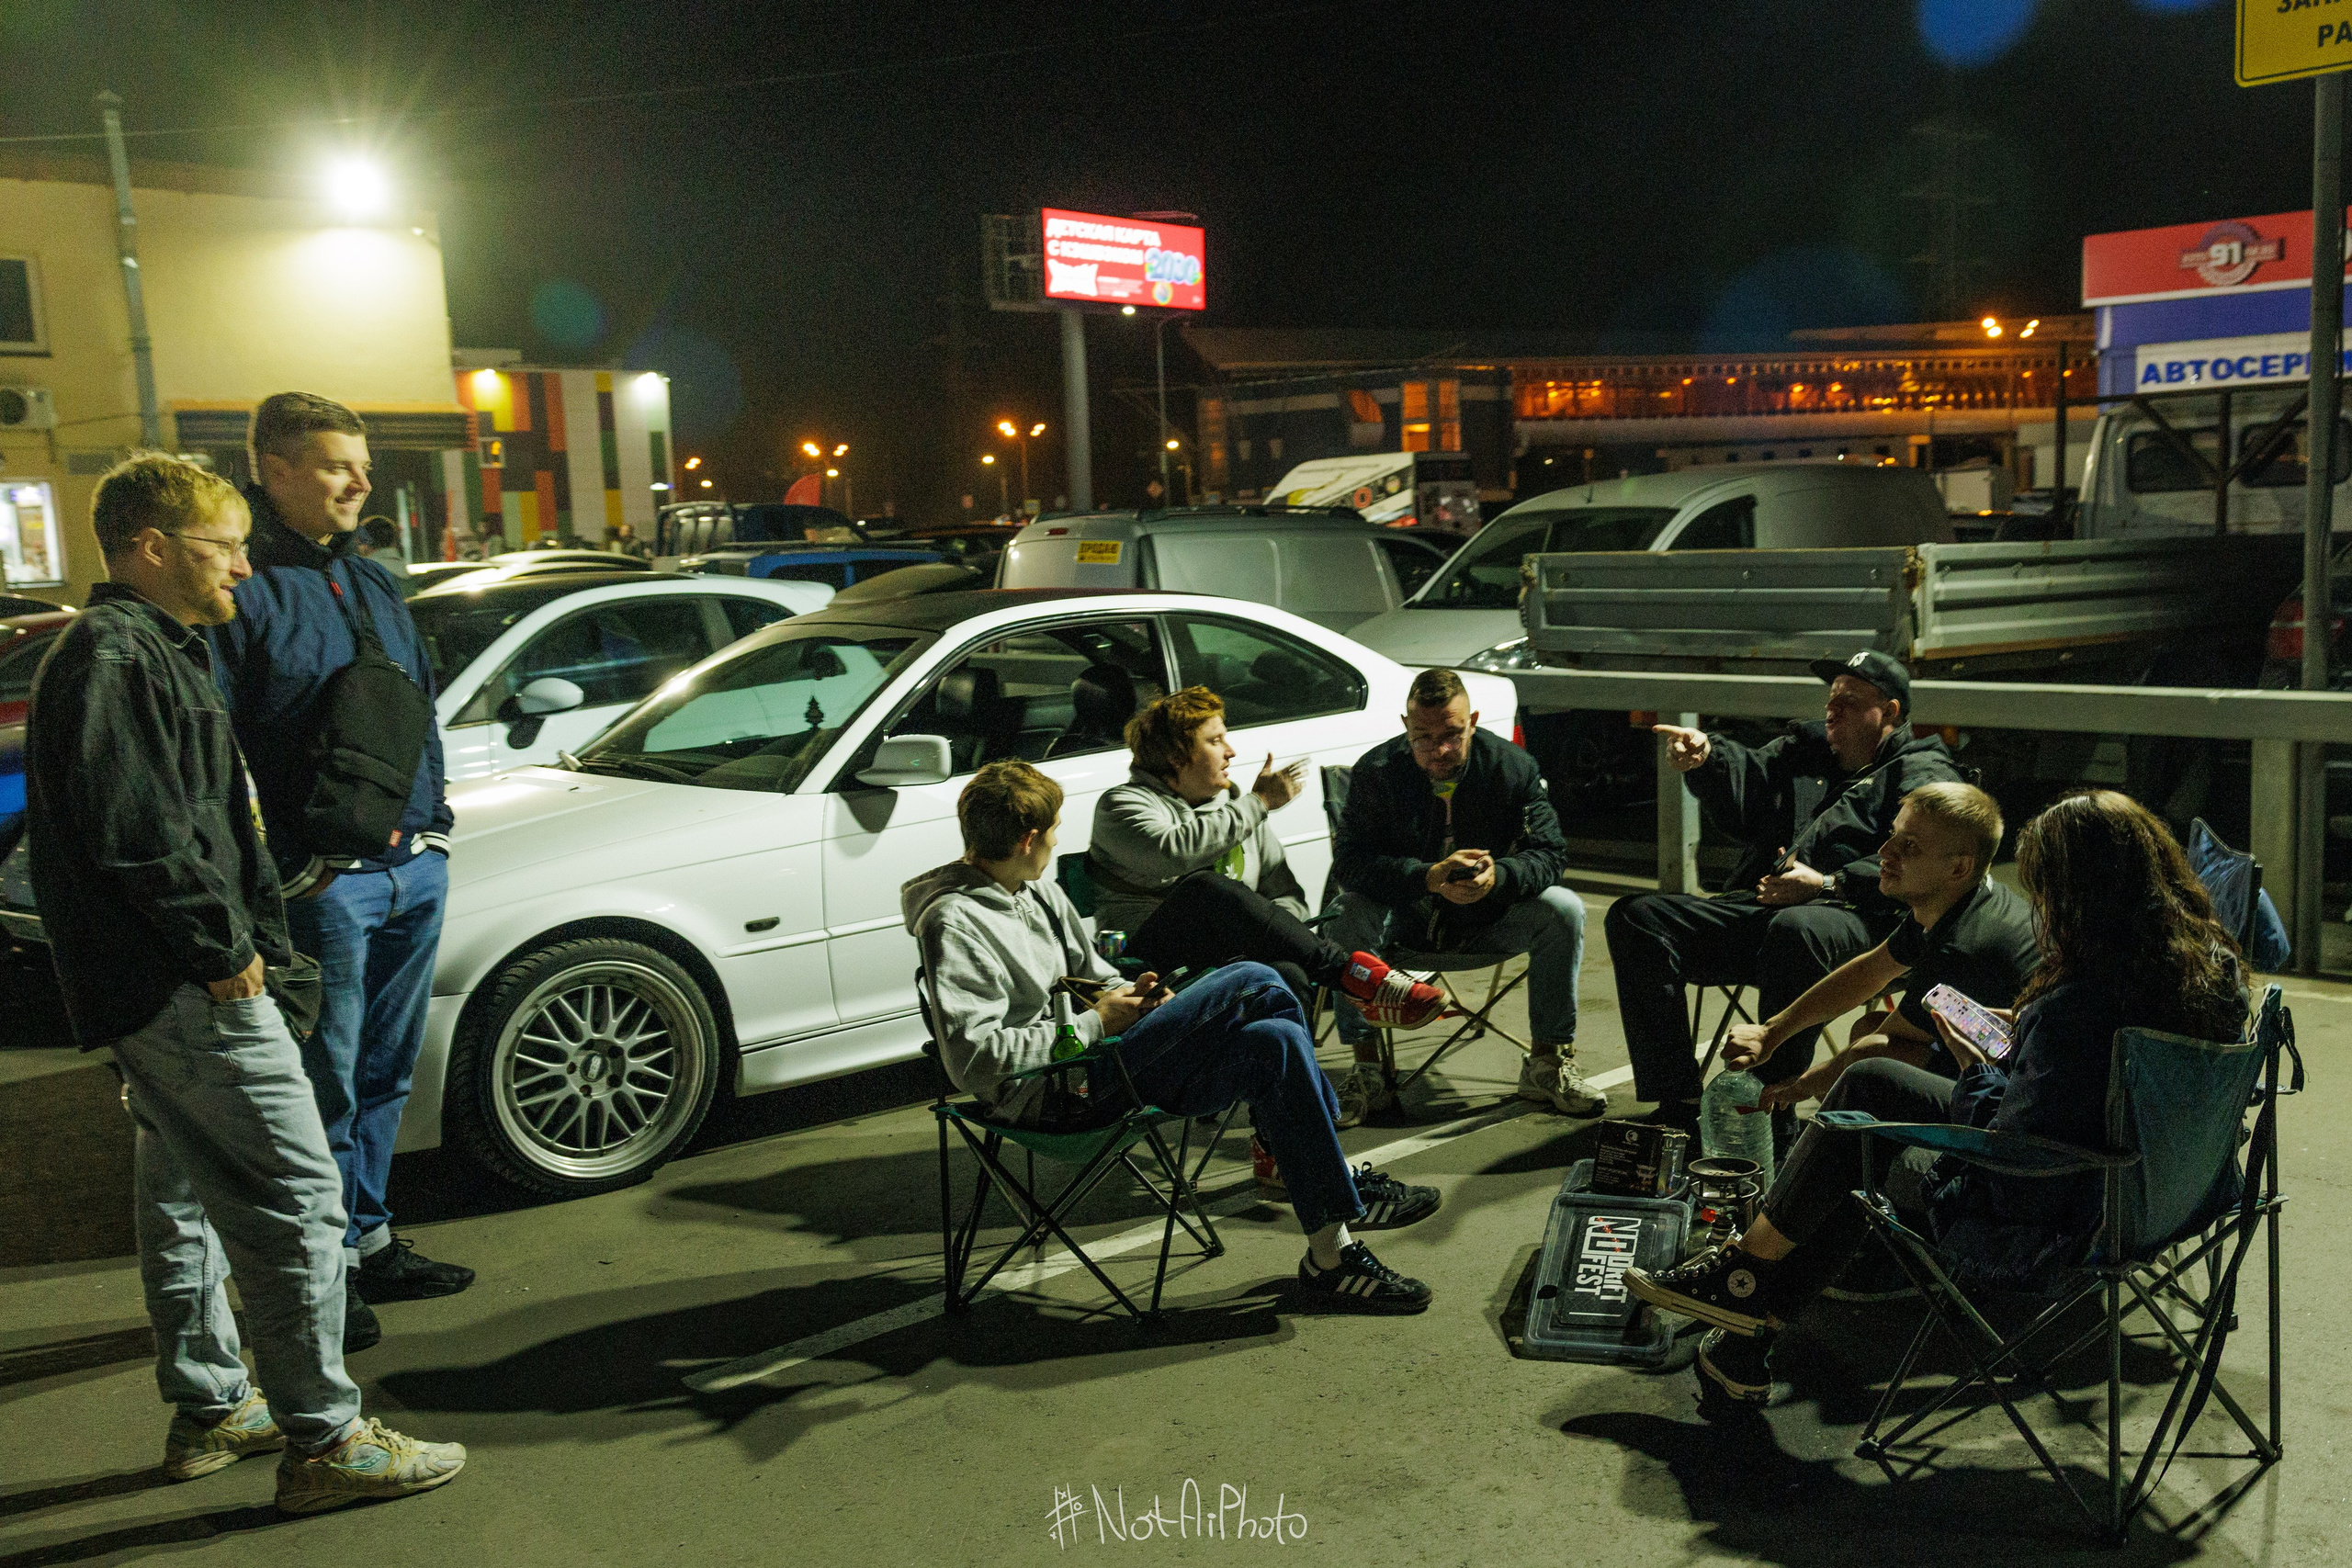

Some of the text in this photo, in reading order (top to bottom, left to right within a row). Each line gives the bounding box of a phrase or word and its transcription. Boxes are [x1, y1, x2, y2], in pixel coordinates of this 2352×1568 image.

[1046, 240, 1060, 256] С
[1115, 227, 1161, 247] КАРТА
[2208, 241, 2244, 267] 91
[1574, 1254, 1607, 1296] FEST
[1600, 1256, 1635, 1303] DRIFT
